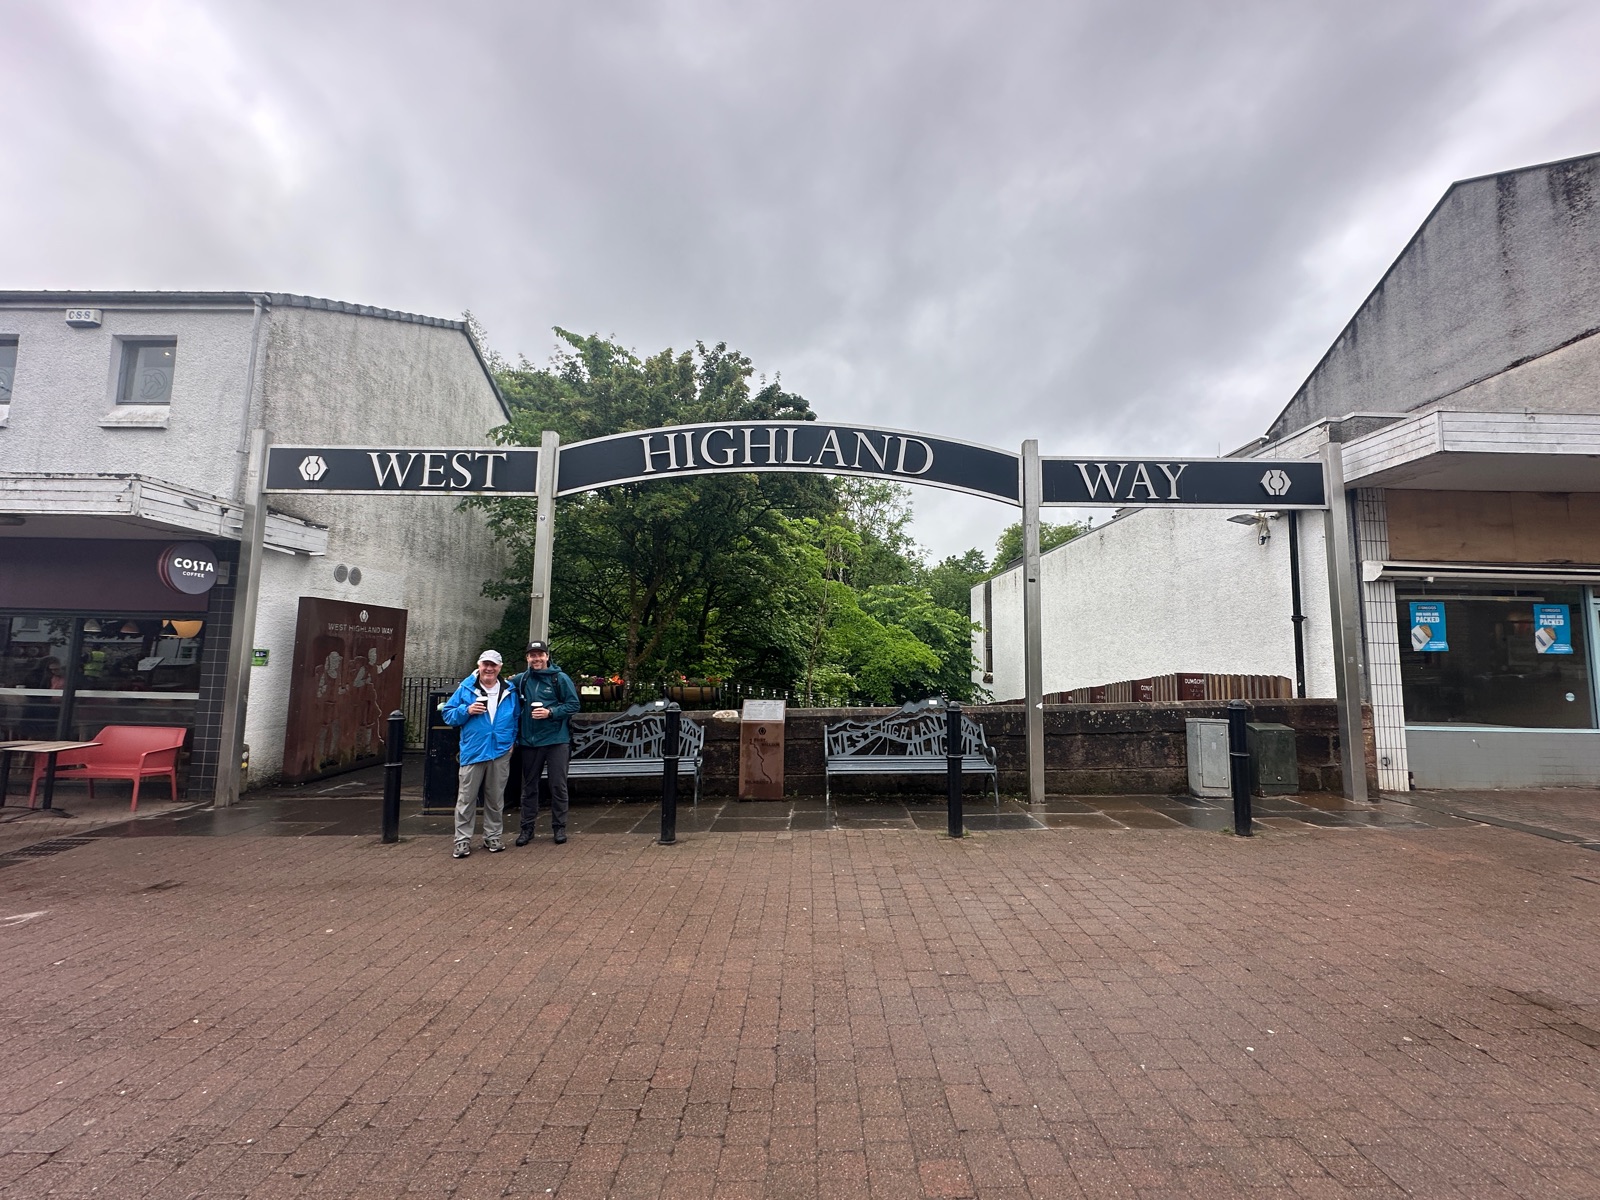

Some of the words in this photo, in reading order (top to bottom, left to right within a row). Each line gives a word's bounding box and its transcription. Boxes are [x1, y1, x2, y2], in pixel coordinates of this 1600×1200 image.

[367, 452, 507, 489] WEST
[639, 427, 934, 475] HIGHLAND
[1074, 463, 1188, 499] WAY
[174, 557, 214, 572] COSTA
[327, 622, 347, 631] WEST
[348, 625, 380, 634] HIGHLAND
[603, 717, 666, 743] HIGHLAN
[681, 719, 701, 740] WAY
[829, 726, 875, 756] WEST
